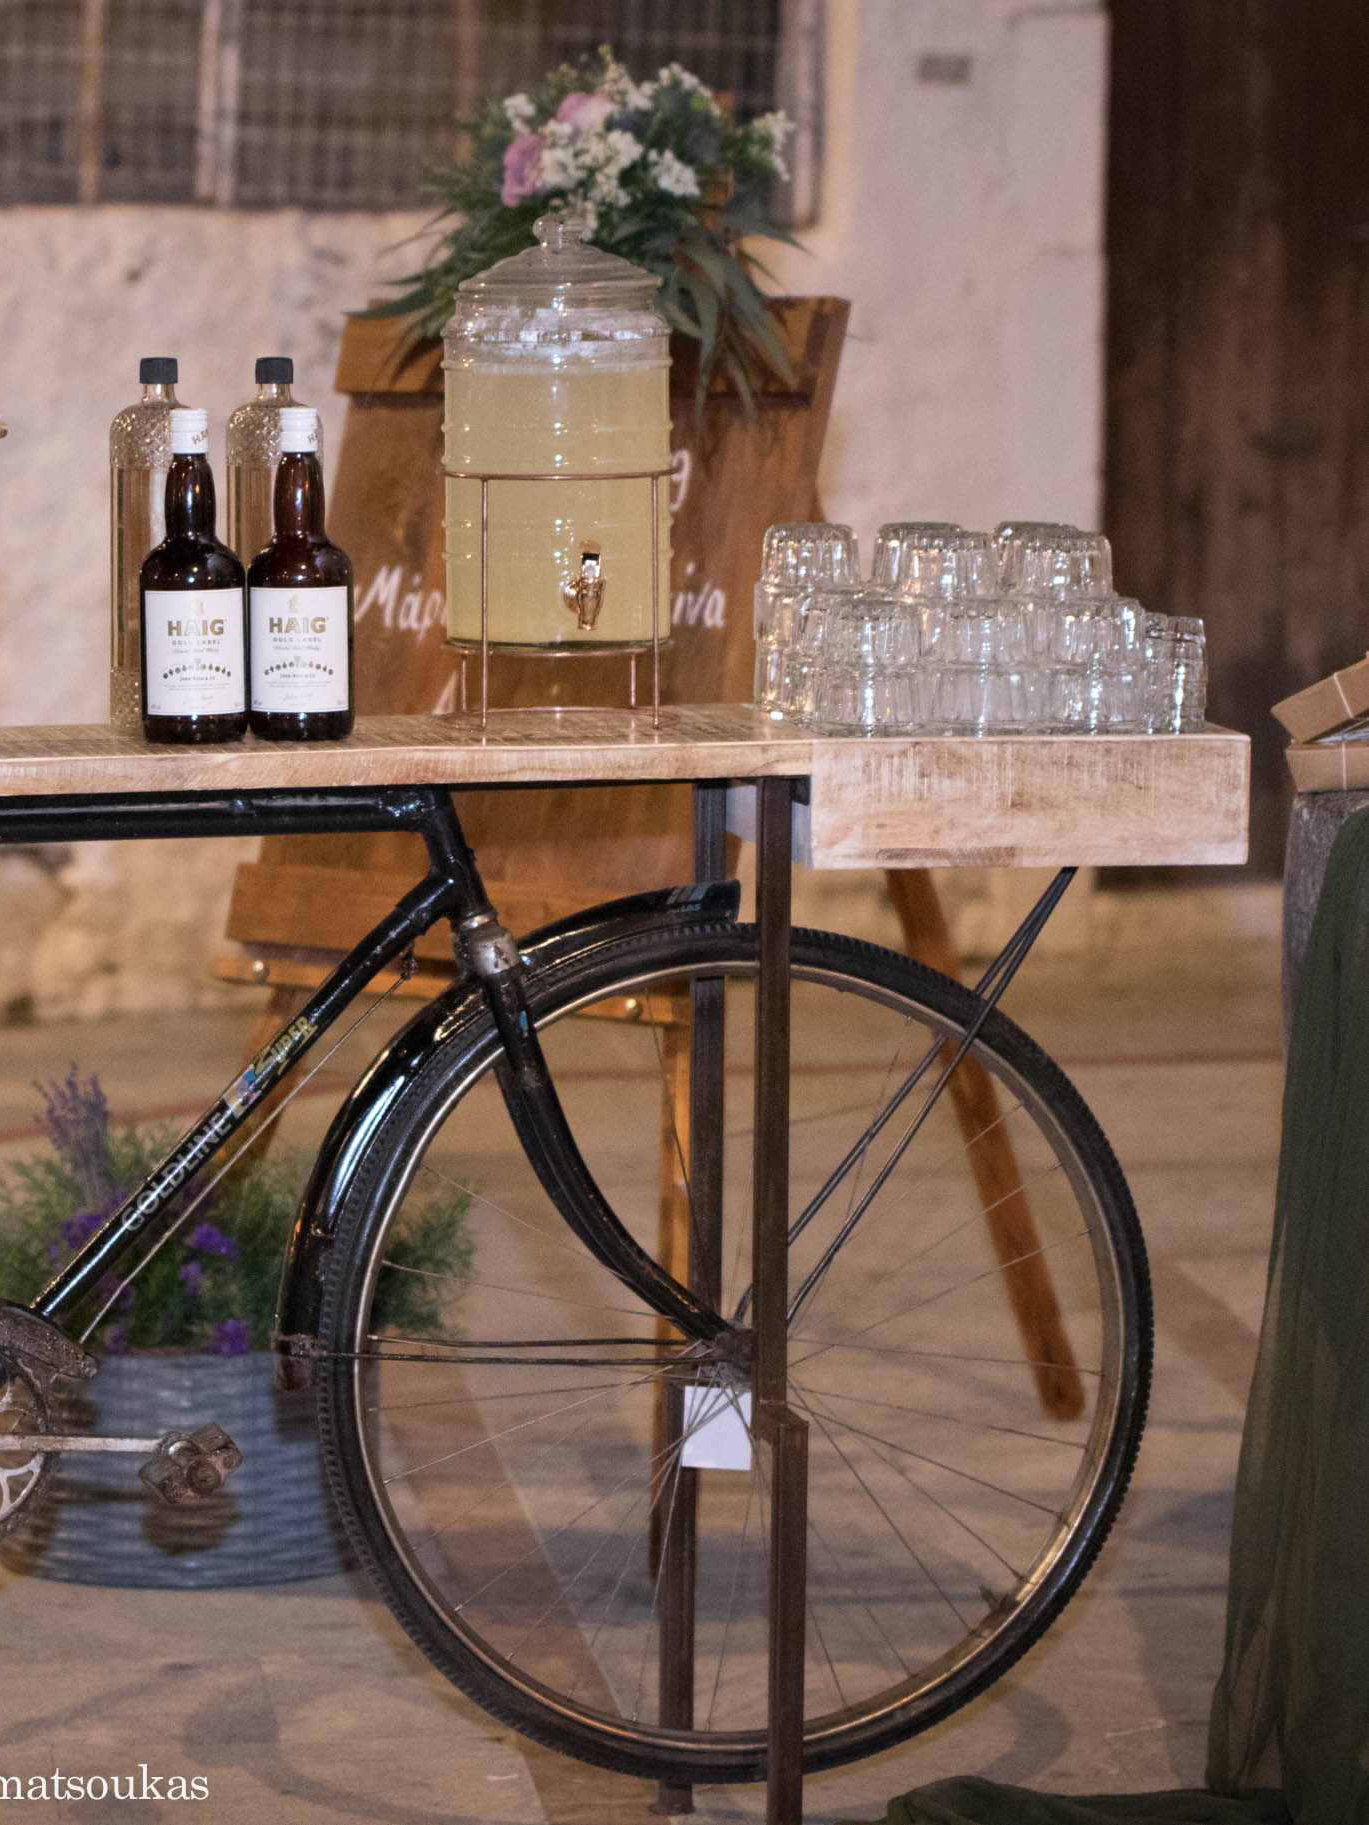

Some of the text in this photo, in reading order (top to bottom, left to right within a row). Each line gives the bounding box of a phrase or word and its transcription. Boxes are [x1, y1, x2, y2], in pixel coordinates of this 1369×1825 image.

[167, 618, 224, 637] HAIG
[268, 616, 327, 634] HAIG
[121, 1111, 231, 1232] GOLDLINE
